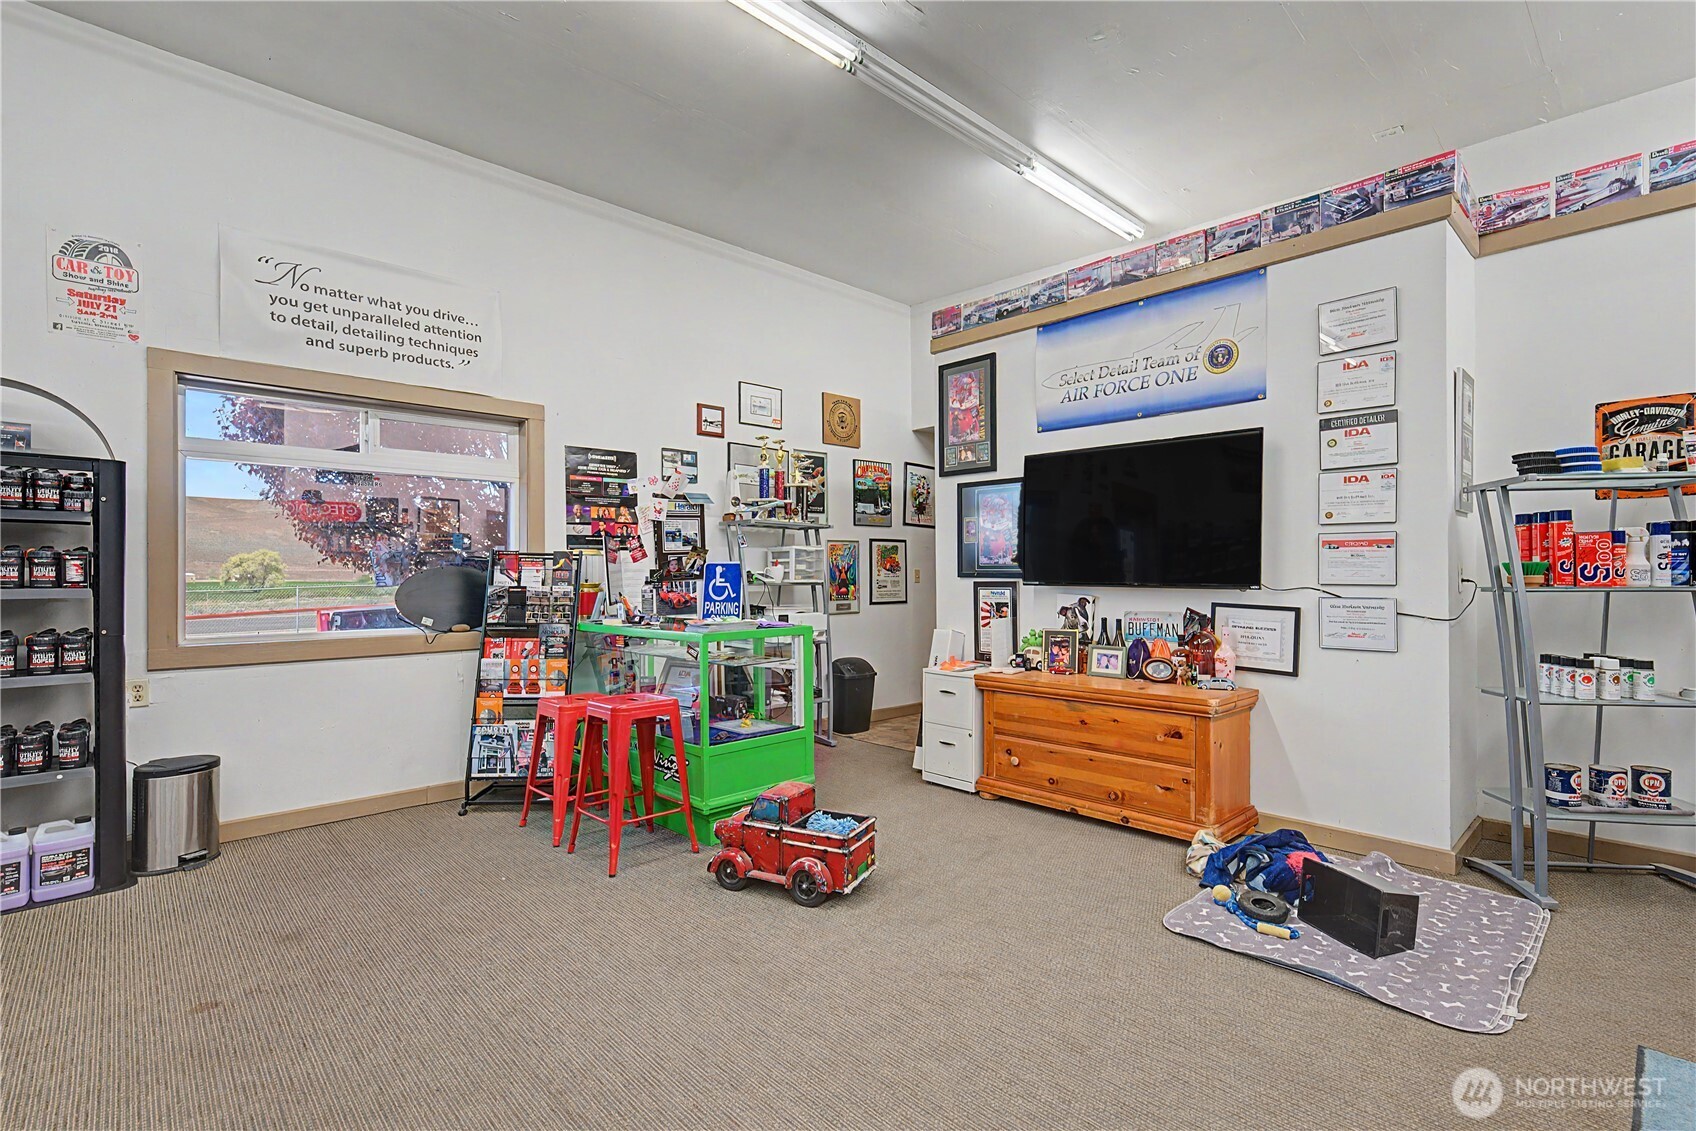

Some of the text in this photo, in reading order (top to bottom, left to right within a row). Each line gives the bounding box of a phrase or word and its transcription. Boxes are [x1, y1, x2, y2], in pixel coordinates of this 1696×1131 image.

[98, 244, 119, 254] 2018
[56, 257, 135, 282] CAR & TOY
[62, 272, 130, 288] Show and Shine
[66, 288, 126, 306] Saturday
[76, 300, 117, 313] JULY 21
[314, 284, 364, 303] matter
[367, 296, 402, 312] what
[405, 304, 430, 318] you
[268, 293, 482, 344] you get unparalleled attention
[270, 310, 479, 359] to detail, detailing techniques
[305, 336, 335, 350] and
[338, 342, 390, 360] superb
[1058, 345, 1202, 388] Select Detail Team of
[1342, 360, 1369, 371] IDA
[1060, 366, 1200, 404] AIR FORCE ONE
[1330, 413, 1386, 428] CERTIFIED DETAILER
[1610, 406, 1687, 425] HARLEY-DAVIDSON
[1344, 427, 1372, 438] IDA
[1614, 417, 1679, 444] Genuine
[1609, 438, 1686, 462] GARAGE
[1343, 474, 1370, 484] IDA
[1578, 538, 1612, 583] S100
[704, 601, 739, 614] PARKING
[1128, 622, 1178, 638] BUFFMAN
